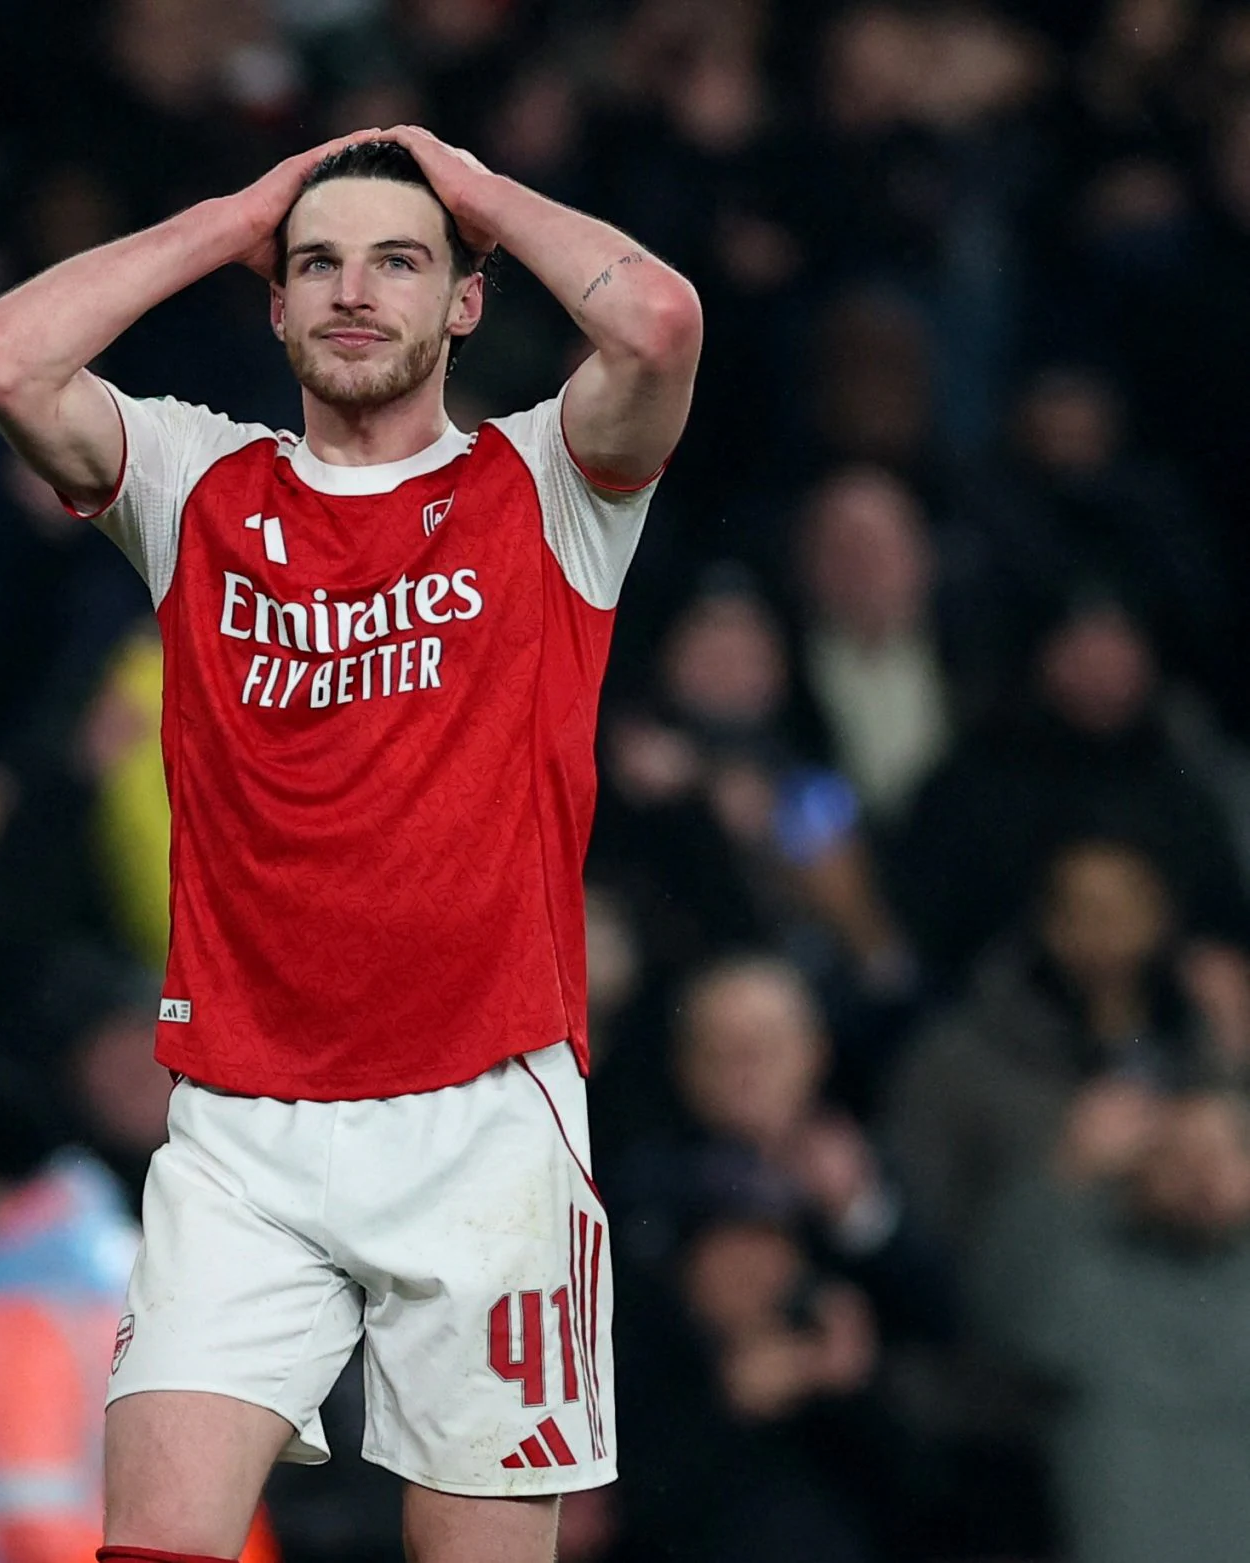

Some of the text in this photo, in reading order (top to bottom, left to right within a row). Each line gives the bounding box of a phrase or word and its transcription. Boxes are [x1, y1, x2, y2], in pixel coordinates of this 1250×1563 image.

[220, 568, 483, 653] Emirates
[241, 636, 442, 709] FLY BETTER
[487, 1284, 580, 1408] 41
